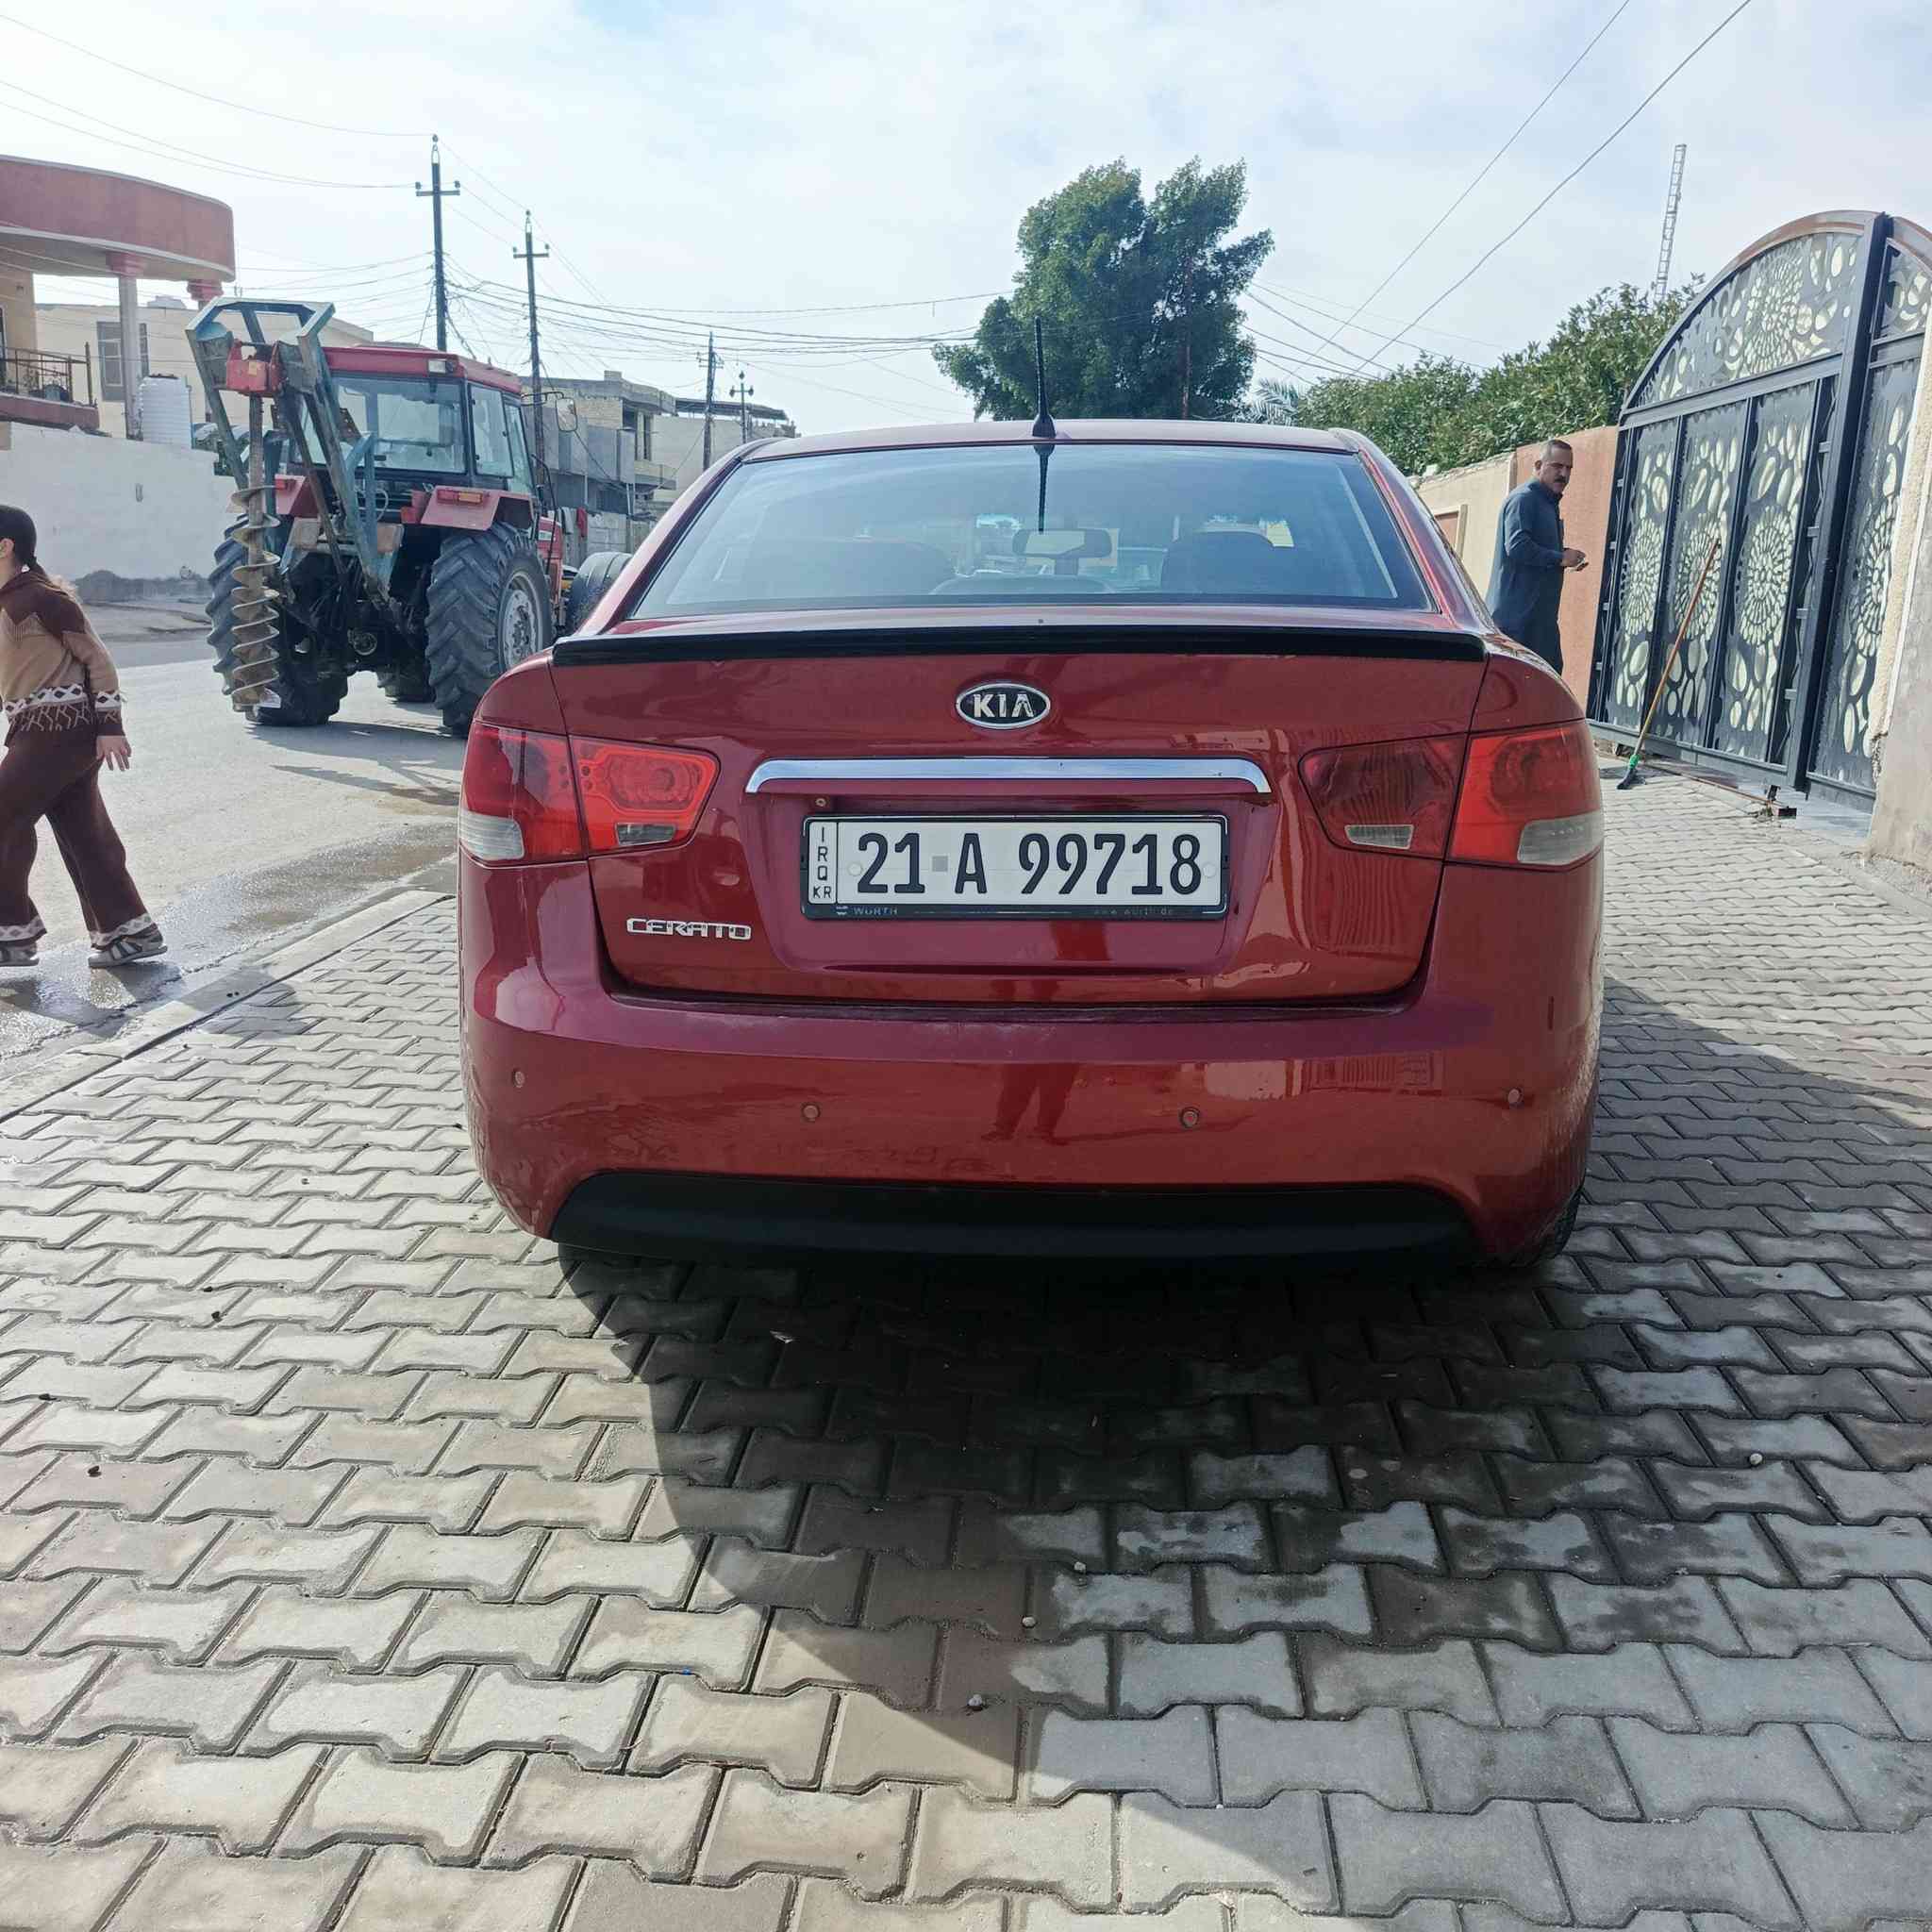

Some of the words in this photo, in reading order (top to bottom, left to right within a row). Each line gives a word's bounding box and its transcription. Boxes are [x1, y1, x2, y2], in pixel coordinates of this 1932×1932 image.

[973, 692, 1035, 718] KIA
[857, 832, 925, 894] 21
[954, 832, 988, 894] A
[1018, 833, 1202, 895] 99718
[812, 886, 832, 899] KR
[626, 917, 752, 941] CERATO
